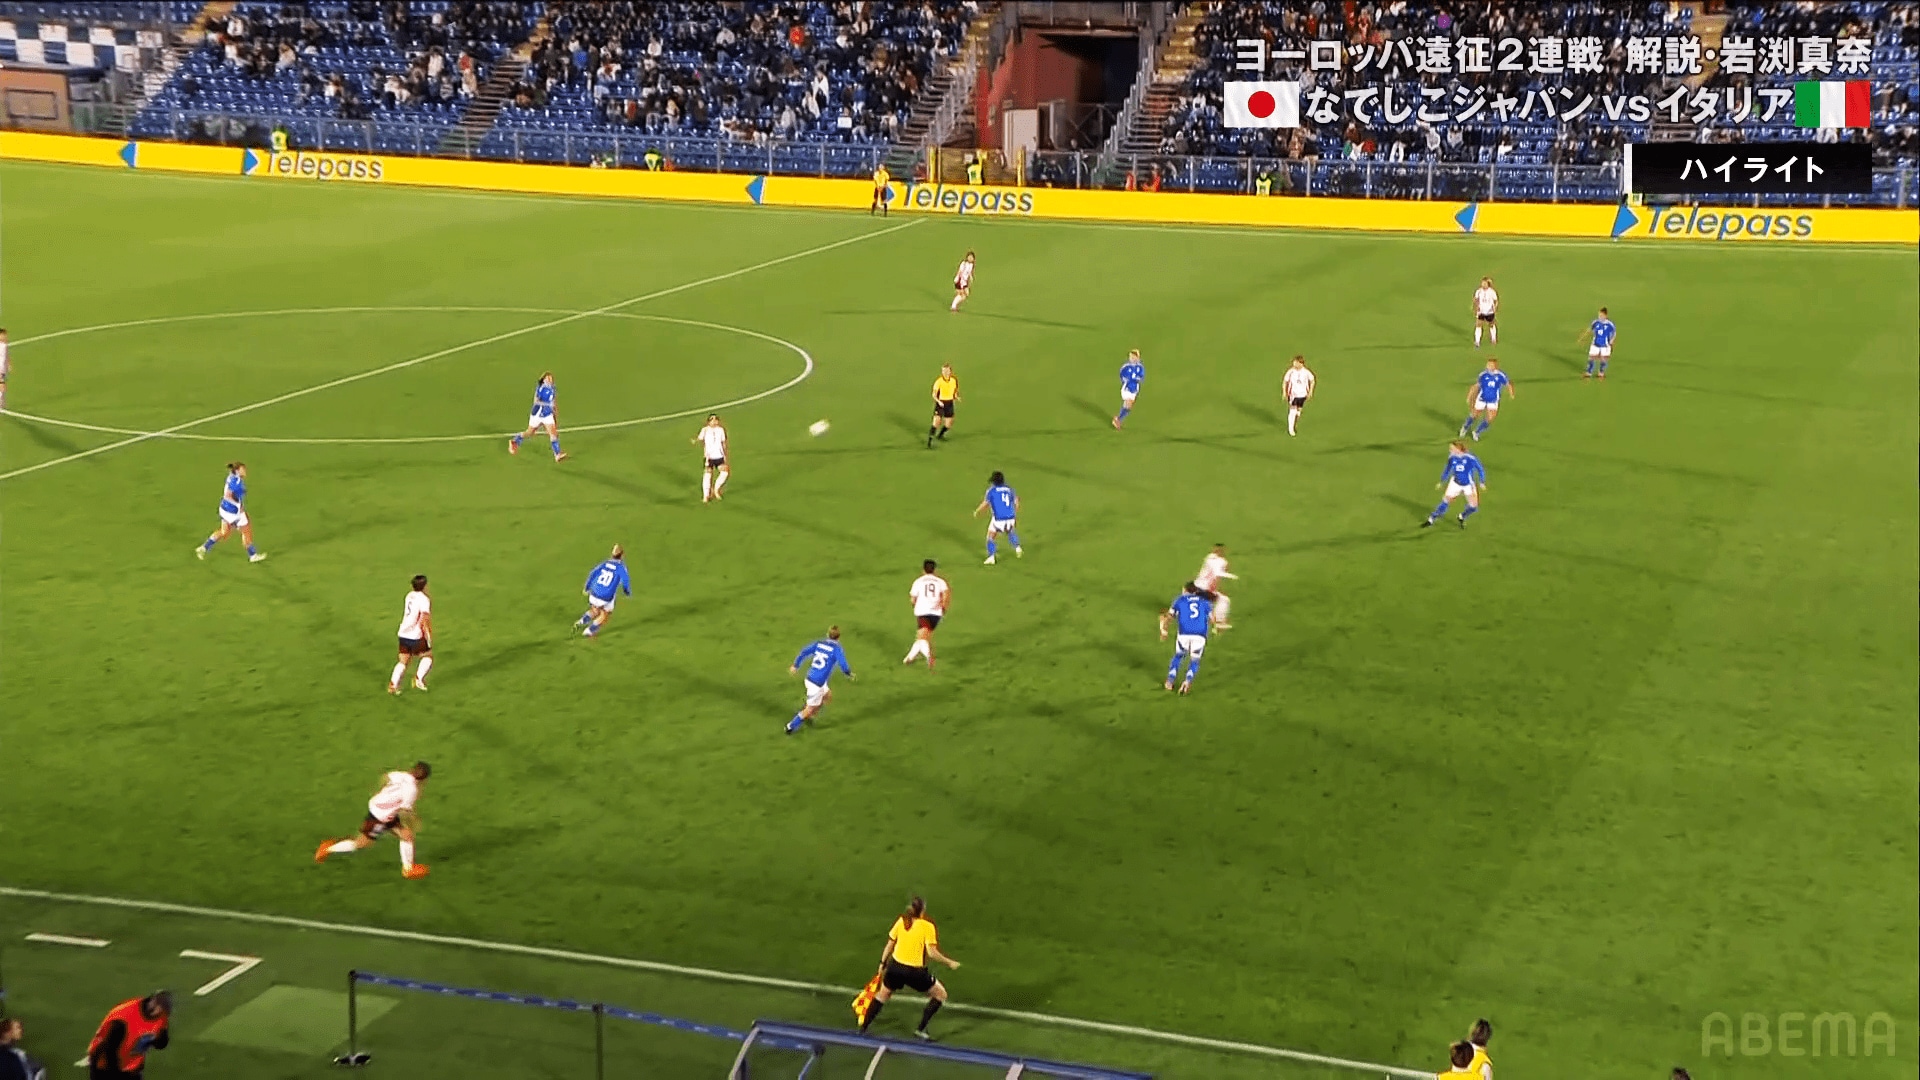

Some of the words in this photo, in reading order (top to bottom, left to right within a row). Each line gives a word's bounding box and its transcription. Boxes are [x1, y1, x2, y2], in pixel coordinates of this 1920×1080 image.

[902, 182, 1033, 215] Telepass
[1647, 205, 1813, 240] Telepass
[1001, 493, 1010, 507] 4
[596, 569, 614, 587] 20
[924, 583, 936, 598] 19
[1189, 603, 1200, 619] 5
